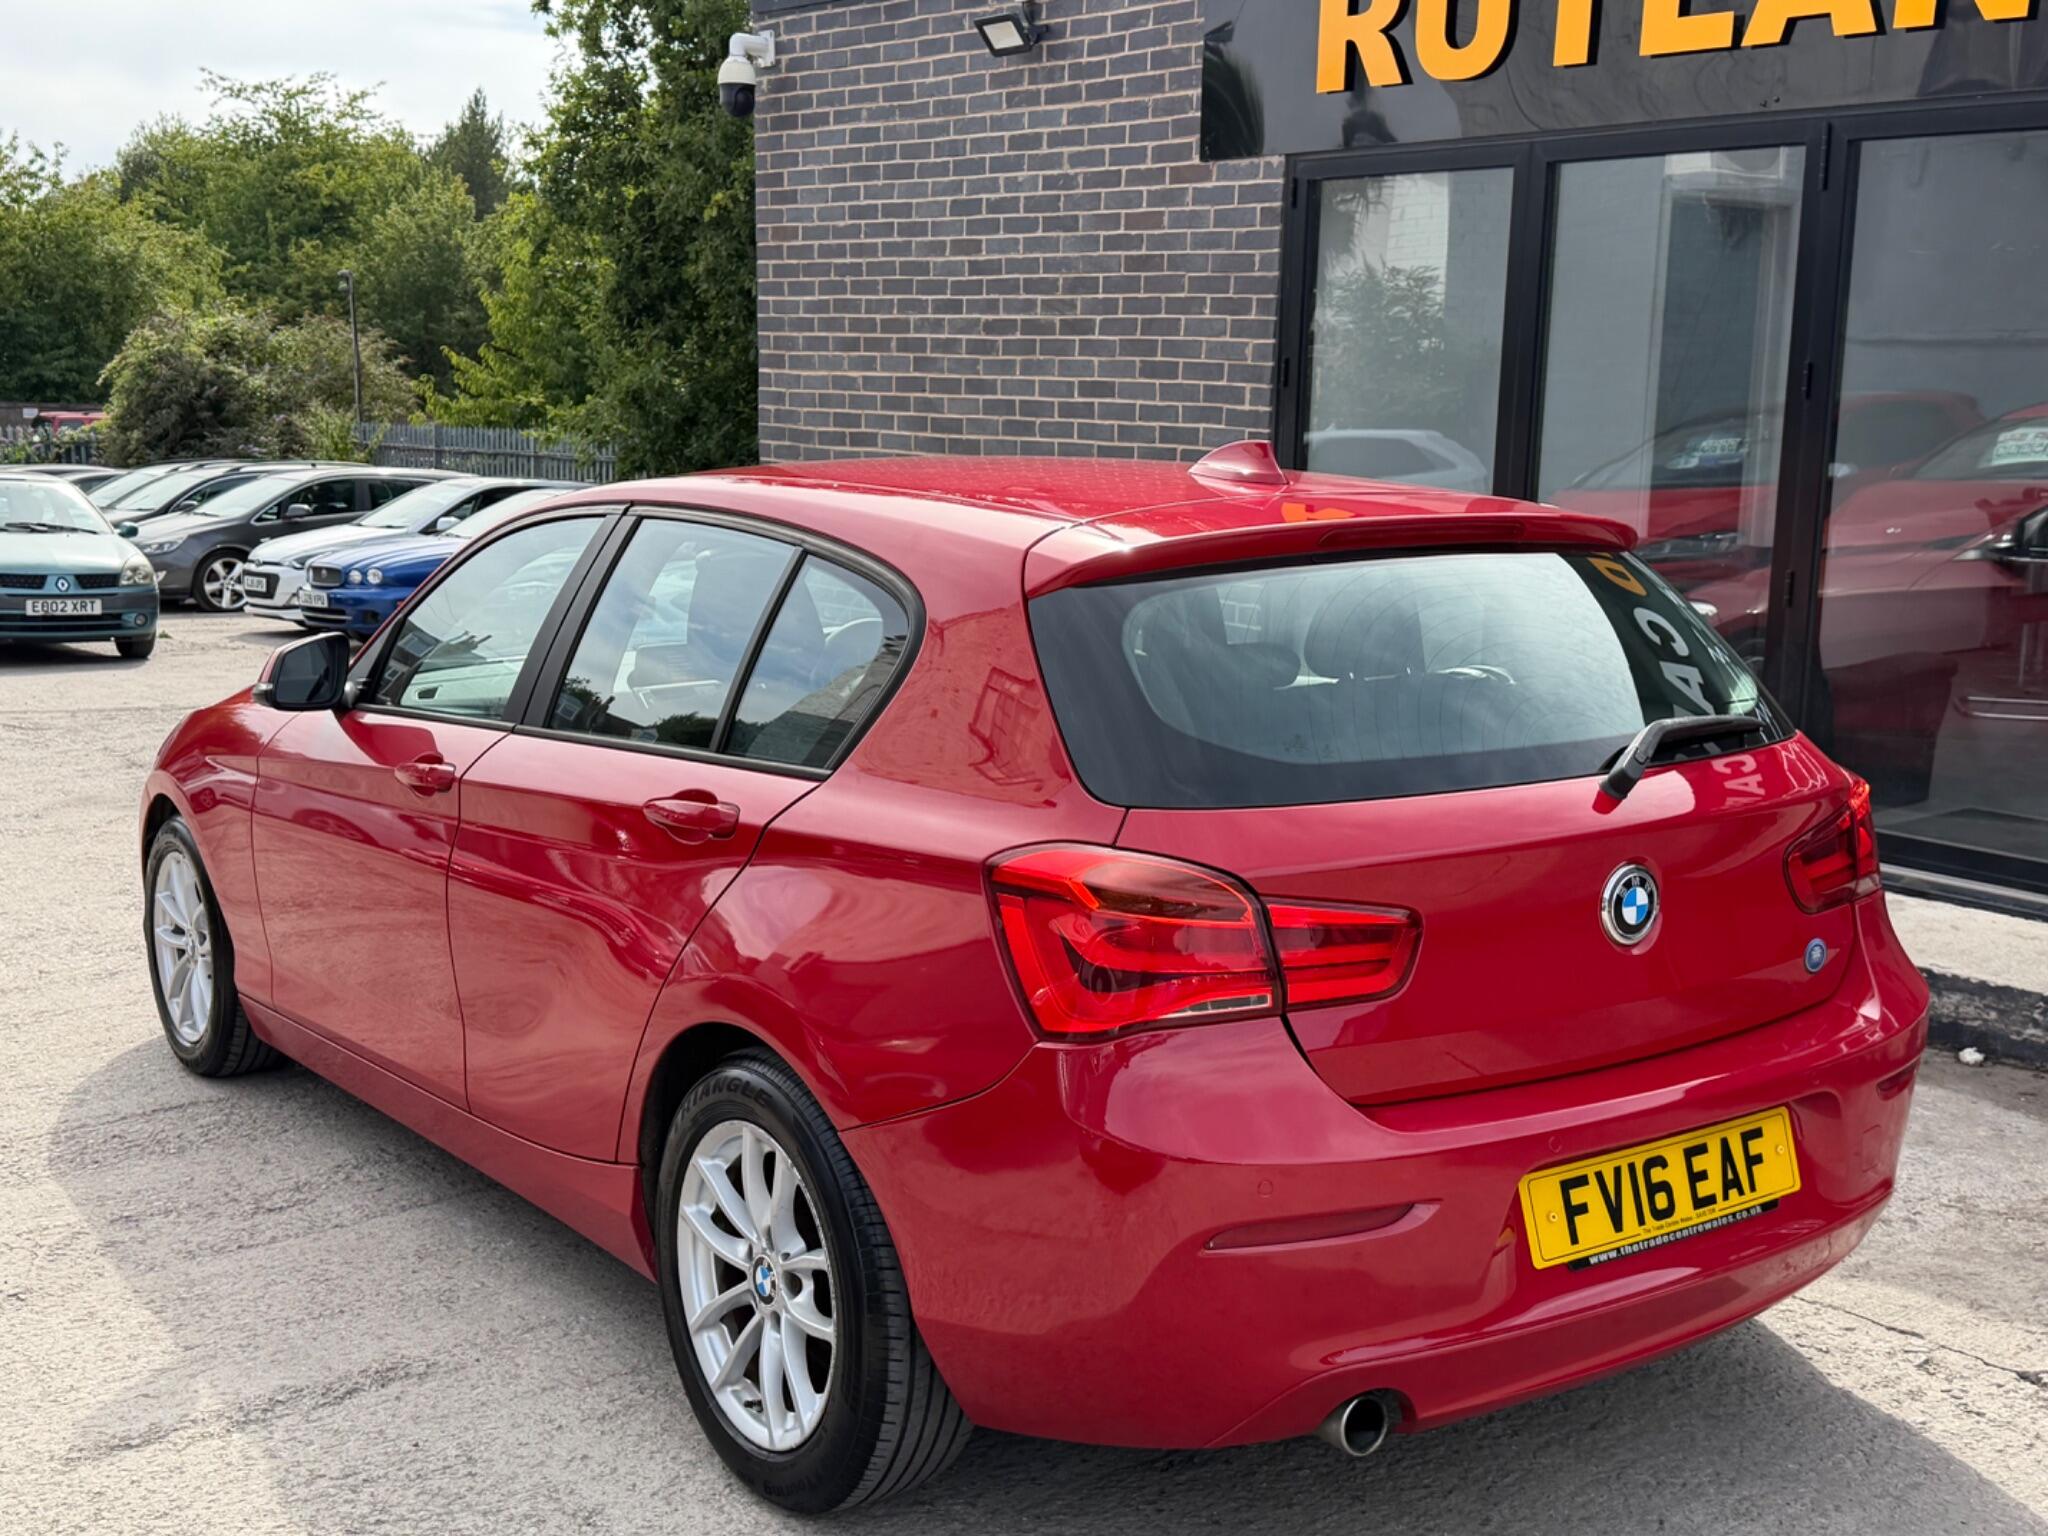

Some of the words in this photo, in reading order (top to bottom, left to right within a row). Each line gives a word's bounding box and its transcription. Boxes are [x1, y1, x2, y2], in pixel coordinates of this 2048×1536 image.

[1316, 0, 2033, 93] RUTL
[71, 600, 96, 613] XRT
[1617, 876, 1655, 898] BMW
[1560, 1154, 1676, 1246] FV16
[1683, 1126, 1764, 1211] EAF
[1588, 1205, 1762, 1265] www.thetradecentrewales.co.uk
